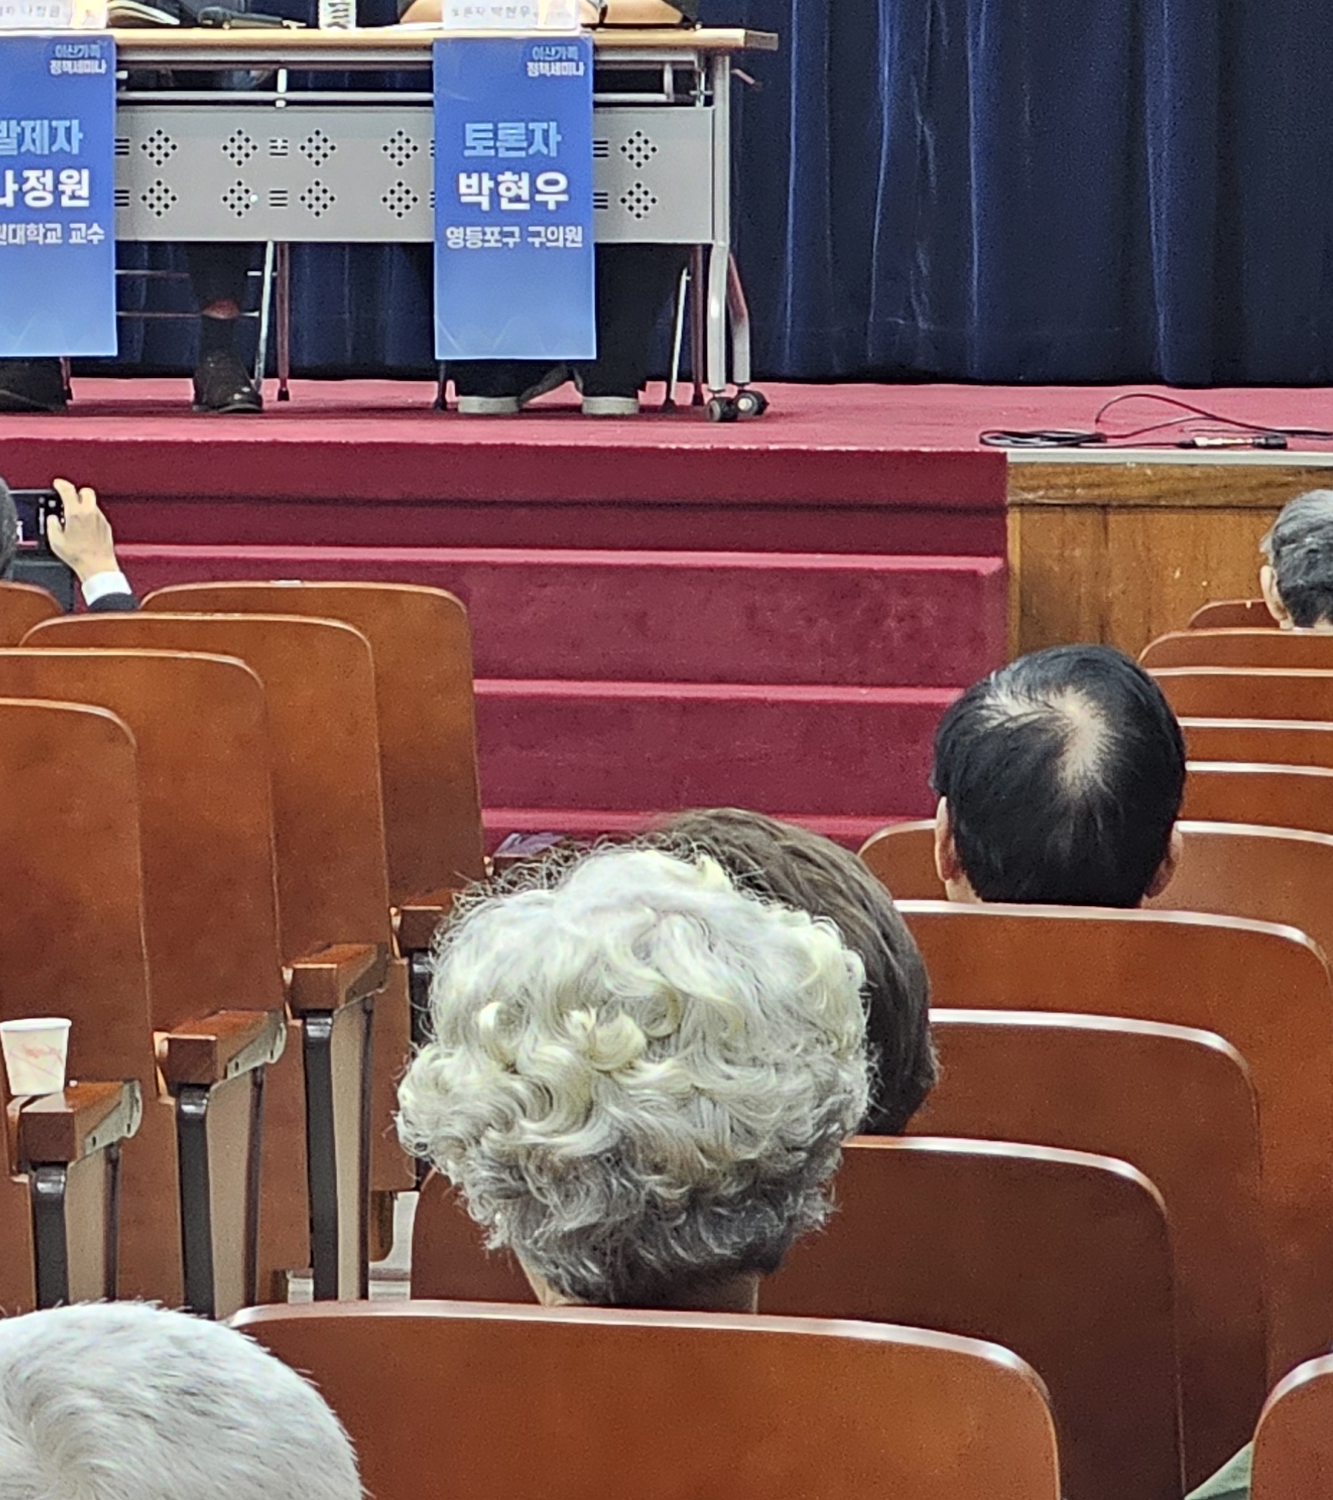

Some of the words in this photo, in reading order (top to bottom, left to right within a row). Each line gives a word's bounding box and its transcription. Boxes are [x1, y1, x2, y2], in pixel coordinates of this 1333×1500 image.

[463, 121, 563, 159] 토론자
[458, 171, 570, 212] 박현우
[68, 222, 106, 246] 교수
[445, 226, 521, 250] 영등포구
[527, 225, 584, 249] 구의원
